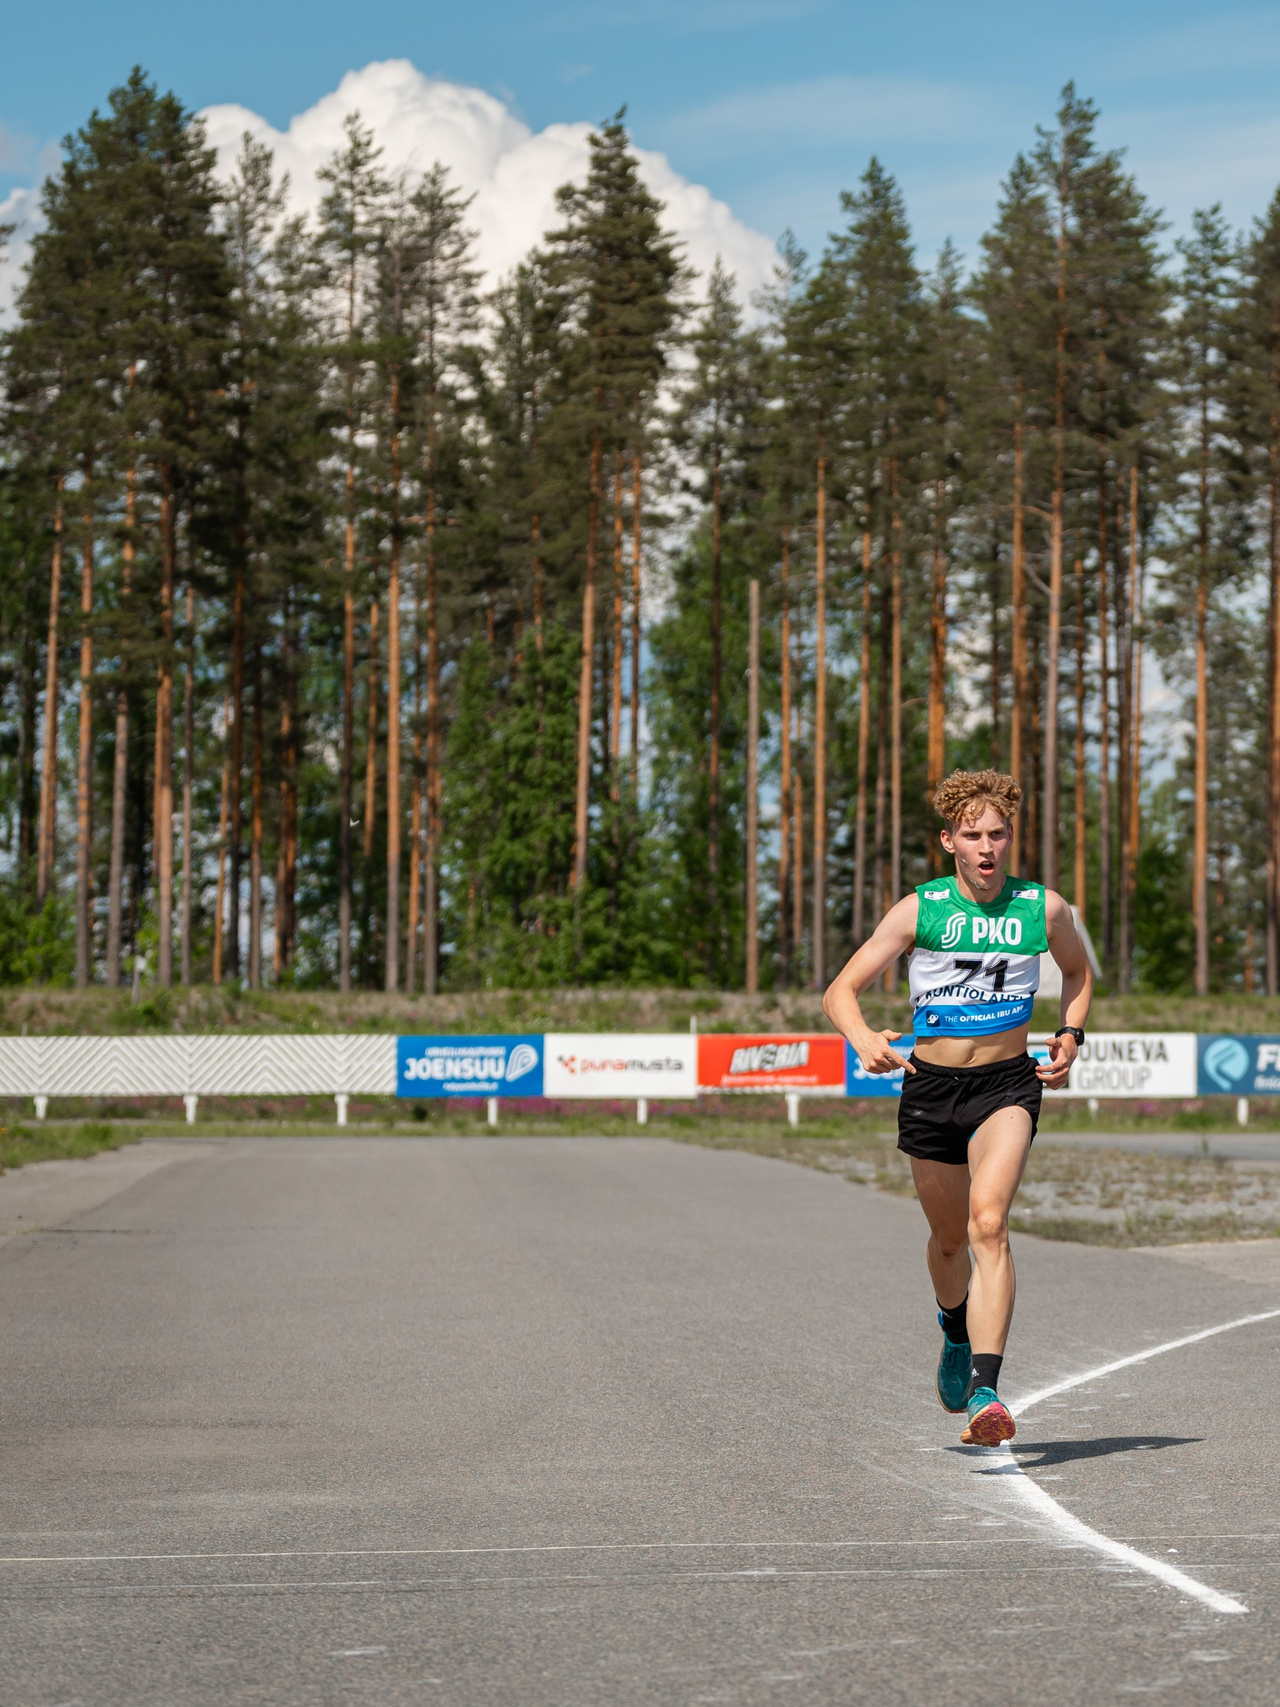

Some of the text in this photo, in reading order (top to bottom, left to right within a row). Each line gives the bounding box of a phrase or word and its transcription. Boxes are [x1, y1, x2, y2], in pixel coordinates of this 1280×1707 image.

[972, 917, 1022, 946] PKO
[953, 958, 1011, 993] 71
[959, 1013, 996, 1022] OFFICIAL
[997, 1009, 1010, 1018] IBU
[403, 1057, 506, 1080] JOENSUU
[580, 1056, 683, 1074] punamusta
[1077, 1066, 1152, 1090] GROUP
